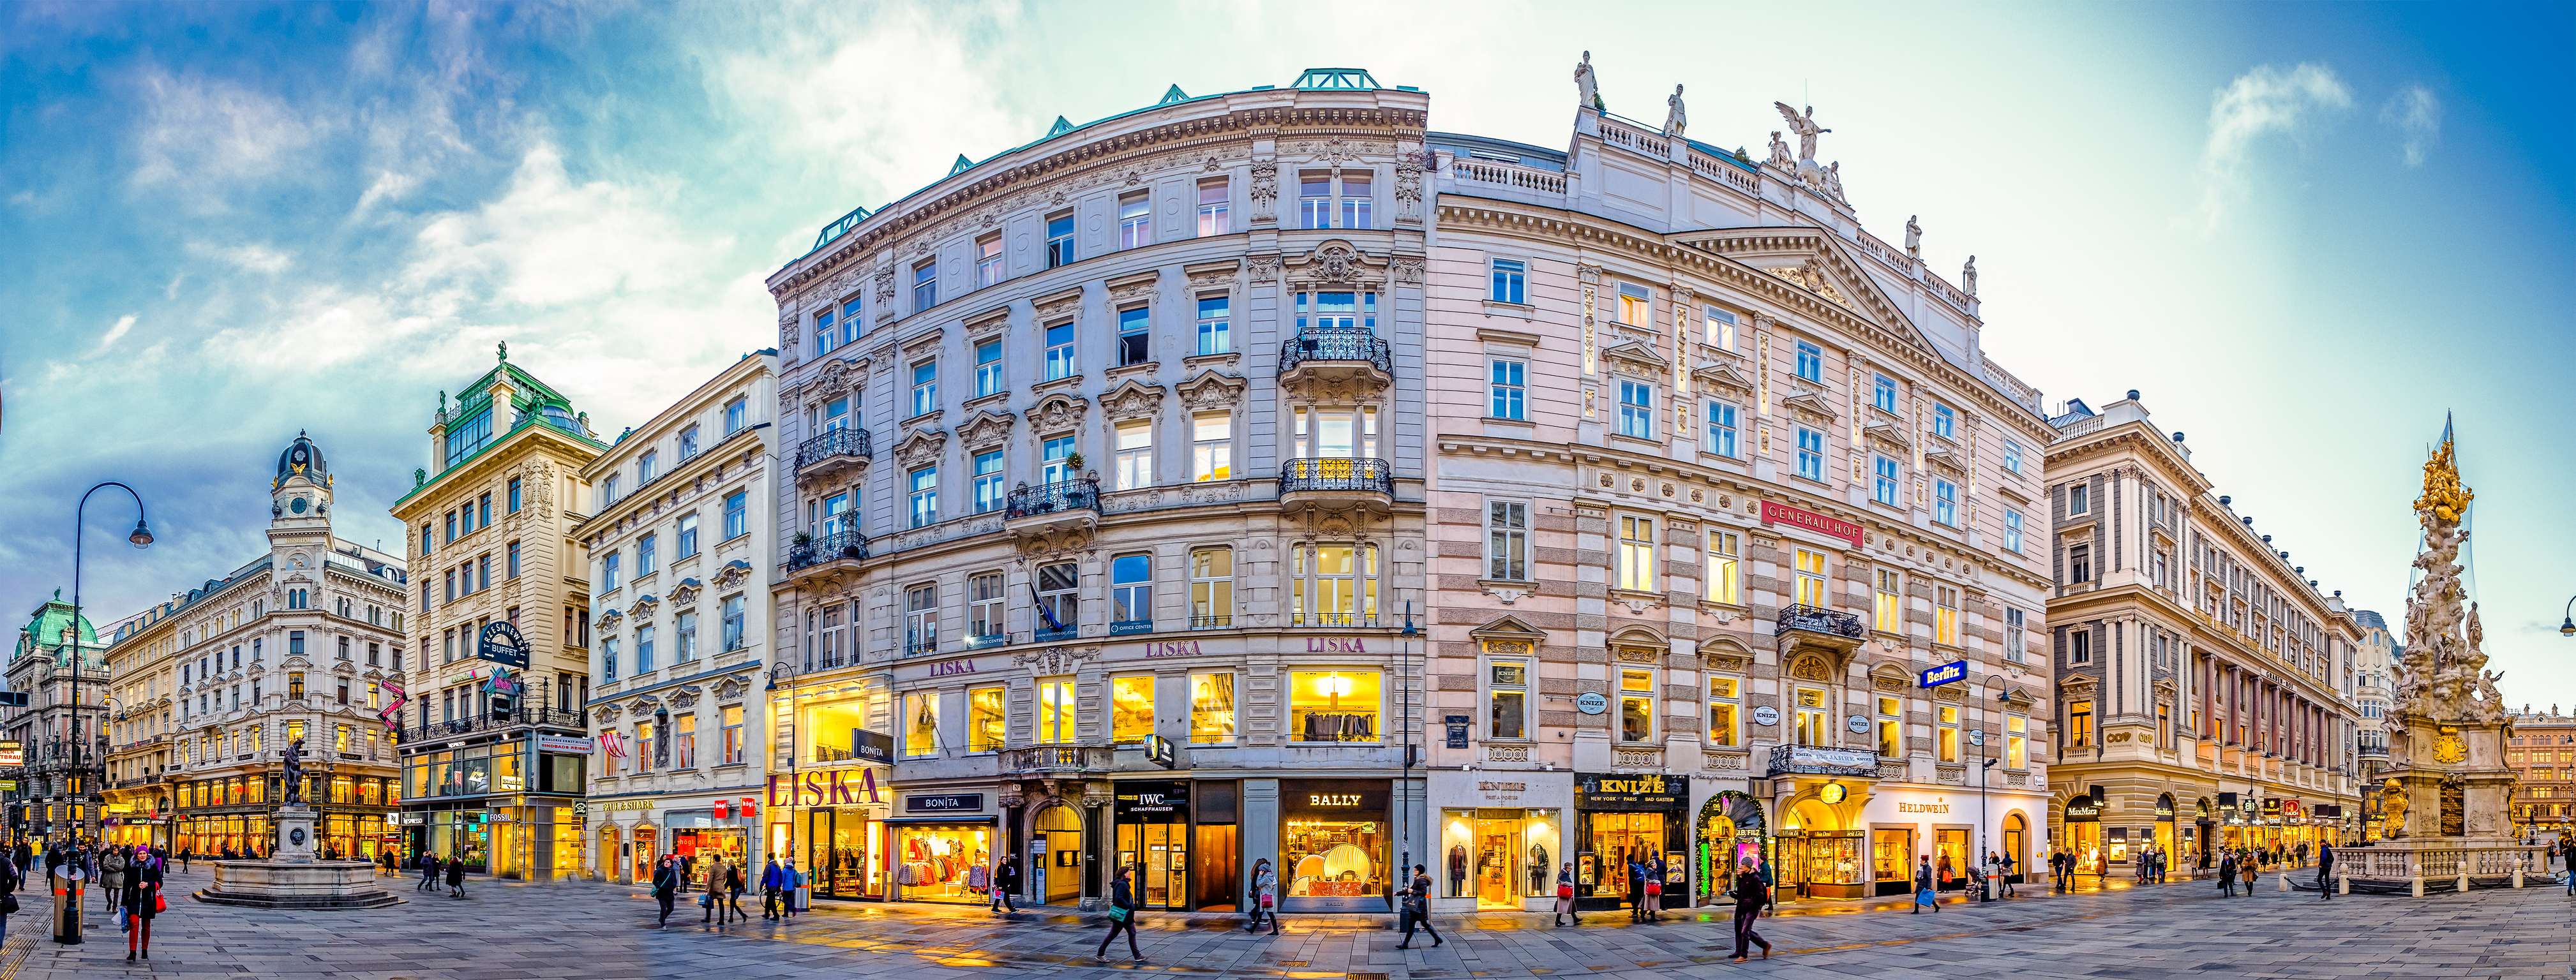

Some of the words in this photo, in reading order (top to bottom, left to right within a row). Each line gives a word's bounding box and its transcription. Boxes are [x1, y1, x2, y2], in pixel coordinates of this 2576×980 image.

[1769, 506, 1858, 537] GENERALI-HOF
[492, 644, 518, 657] BUFFET
[1145, 640, 1202, 658] LISKA
[1306, 637, 1367, 653] LISKA
[929, 659, 976, 678] LISKA
[1927, 665, 1960, 684] Berlitz
[767, 768, 885, 806] LISKA
[1478, 782, 1526, 791] KNIZE
[1601, 780, 1665, 793] KNIZE
[627, 800, 654, 810] SHARK
[1139, 794, 1164, 805] IWC
[1310, 795, 1361, 806] BALLY
[1899, 802, 1949, 814] HELDWEIN
[2067, 807, 2097, 816] MaxMara
[1479, 810, 1512, 819] KNIZE
[680, 838, 695, 847] högl
